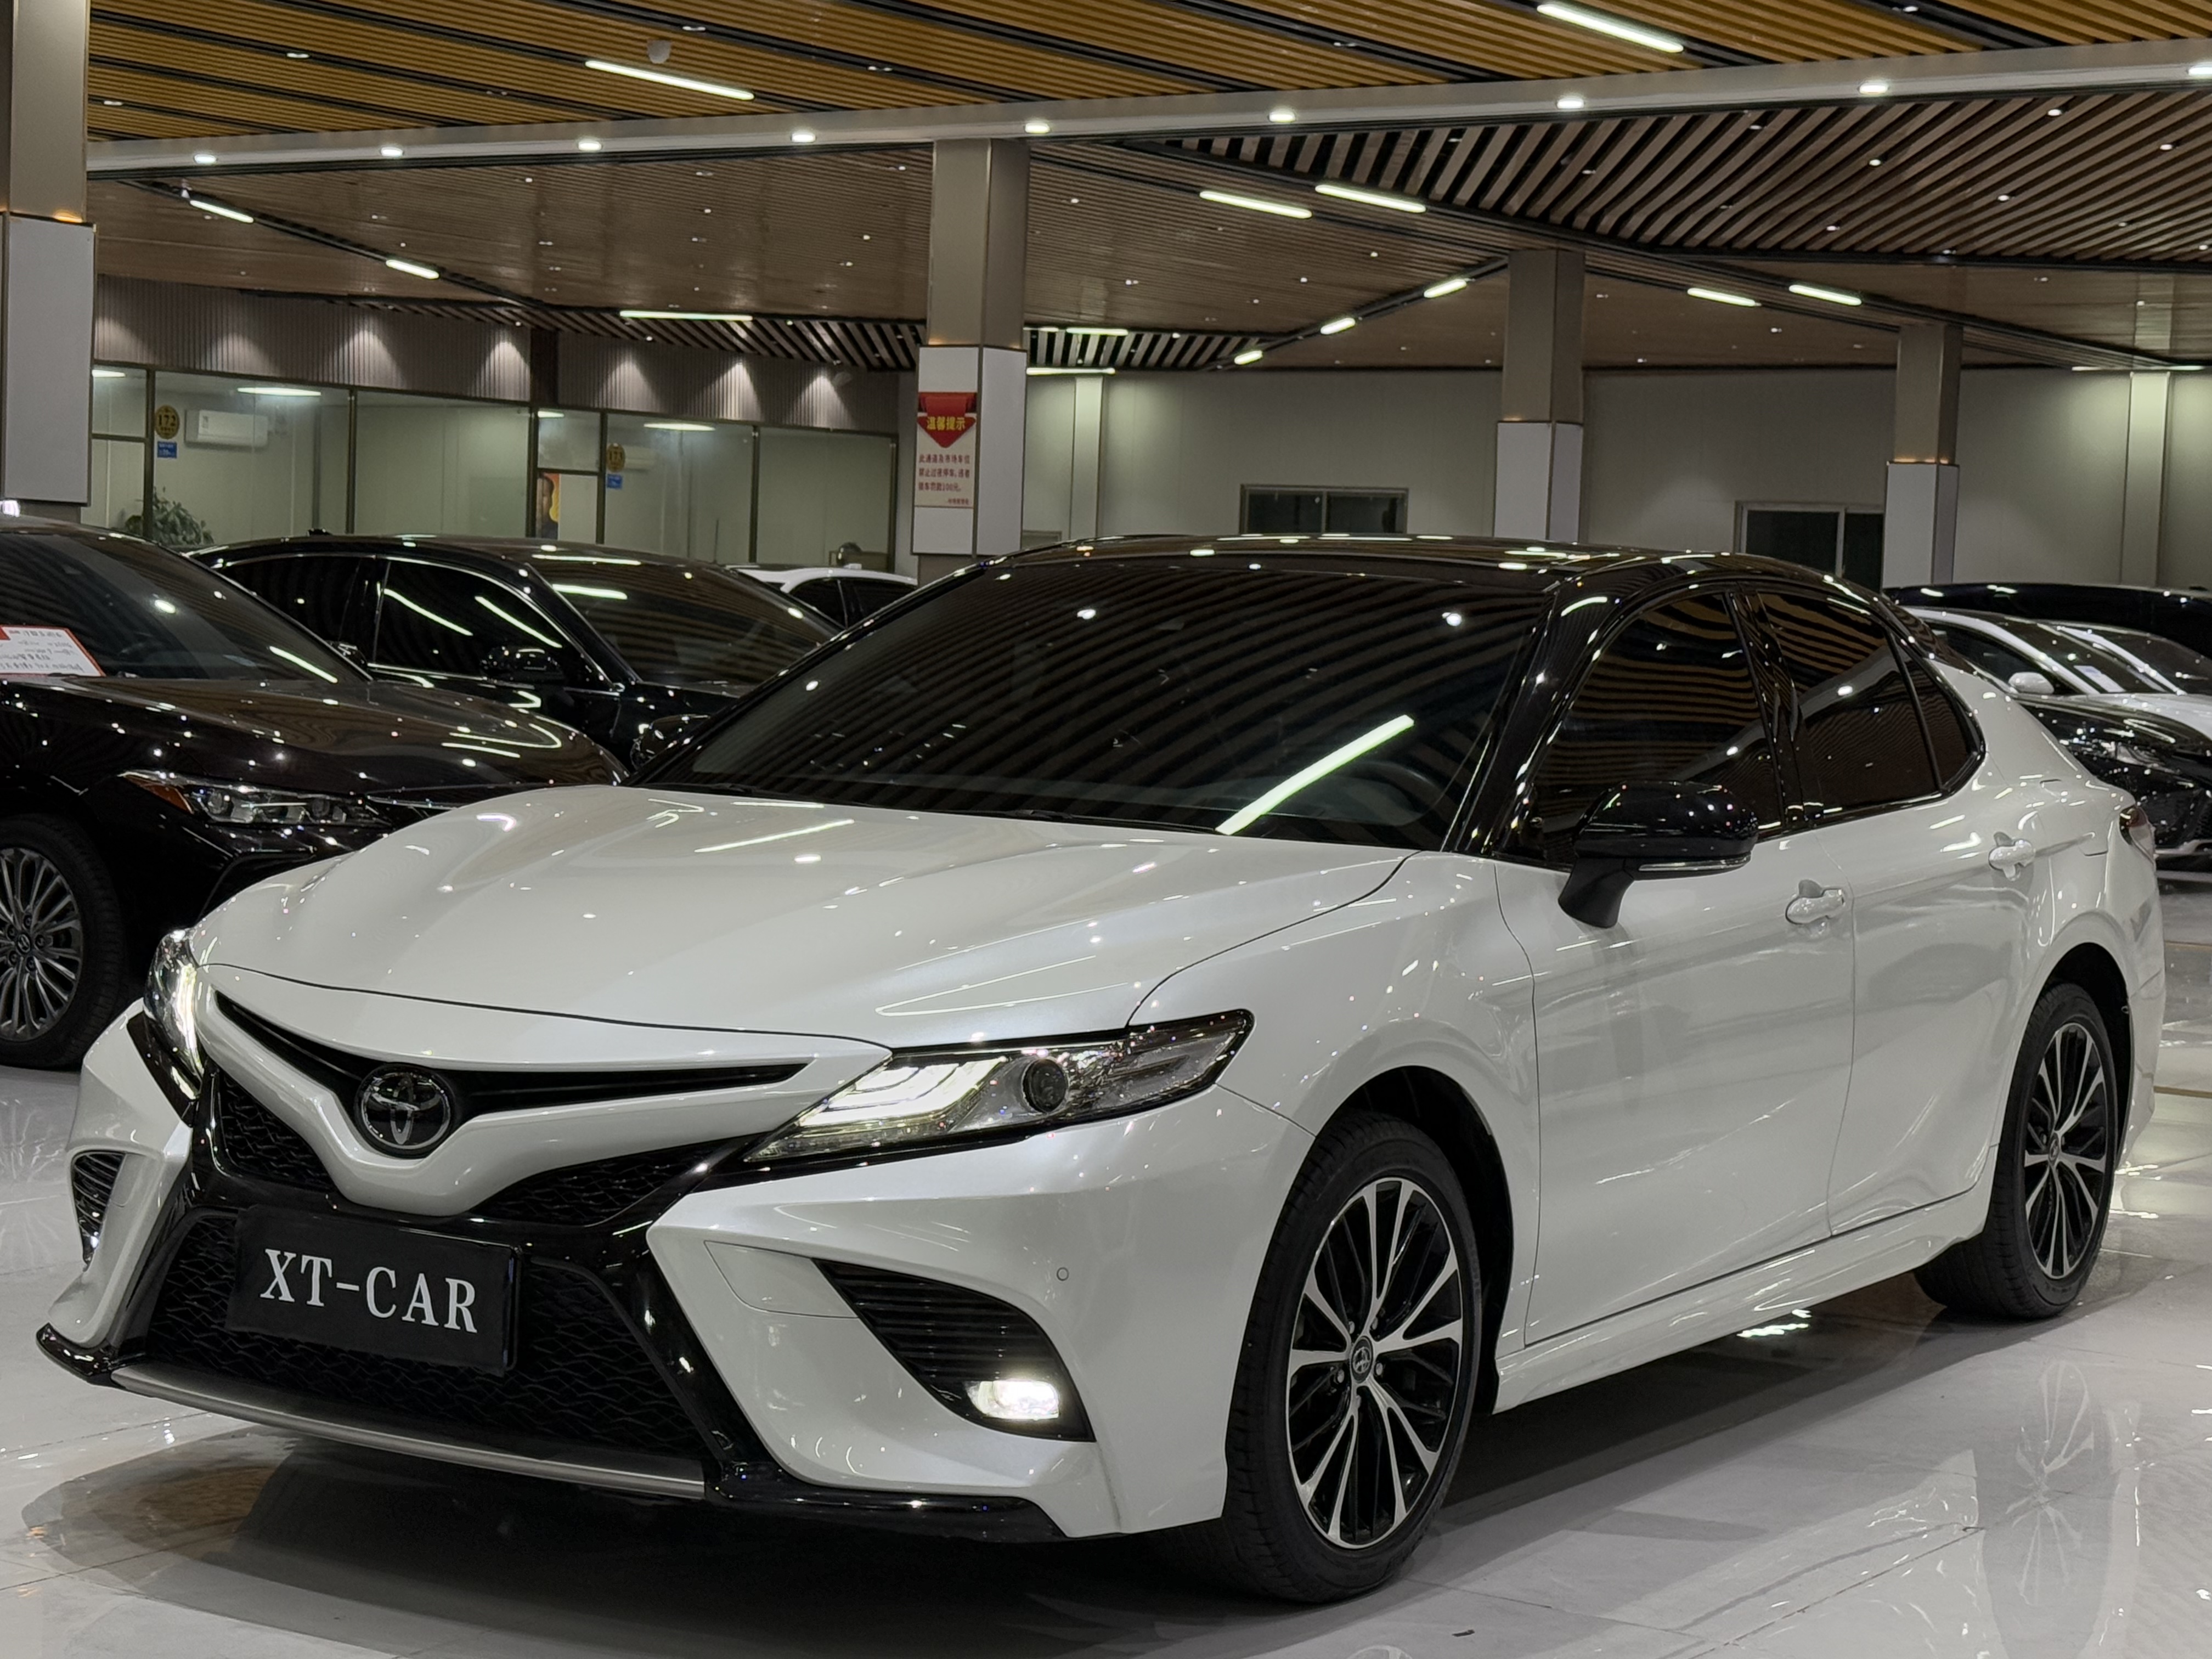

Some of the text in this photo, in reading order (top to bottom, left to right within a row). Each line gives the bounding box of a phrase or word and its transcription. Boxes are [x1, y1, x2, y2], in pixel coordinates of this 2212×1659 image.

[159, 414, 176, 426] 172
[927, 416, 966, 431] 温馨提示
[259, 1248, 478, 1333] XT-CAR
